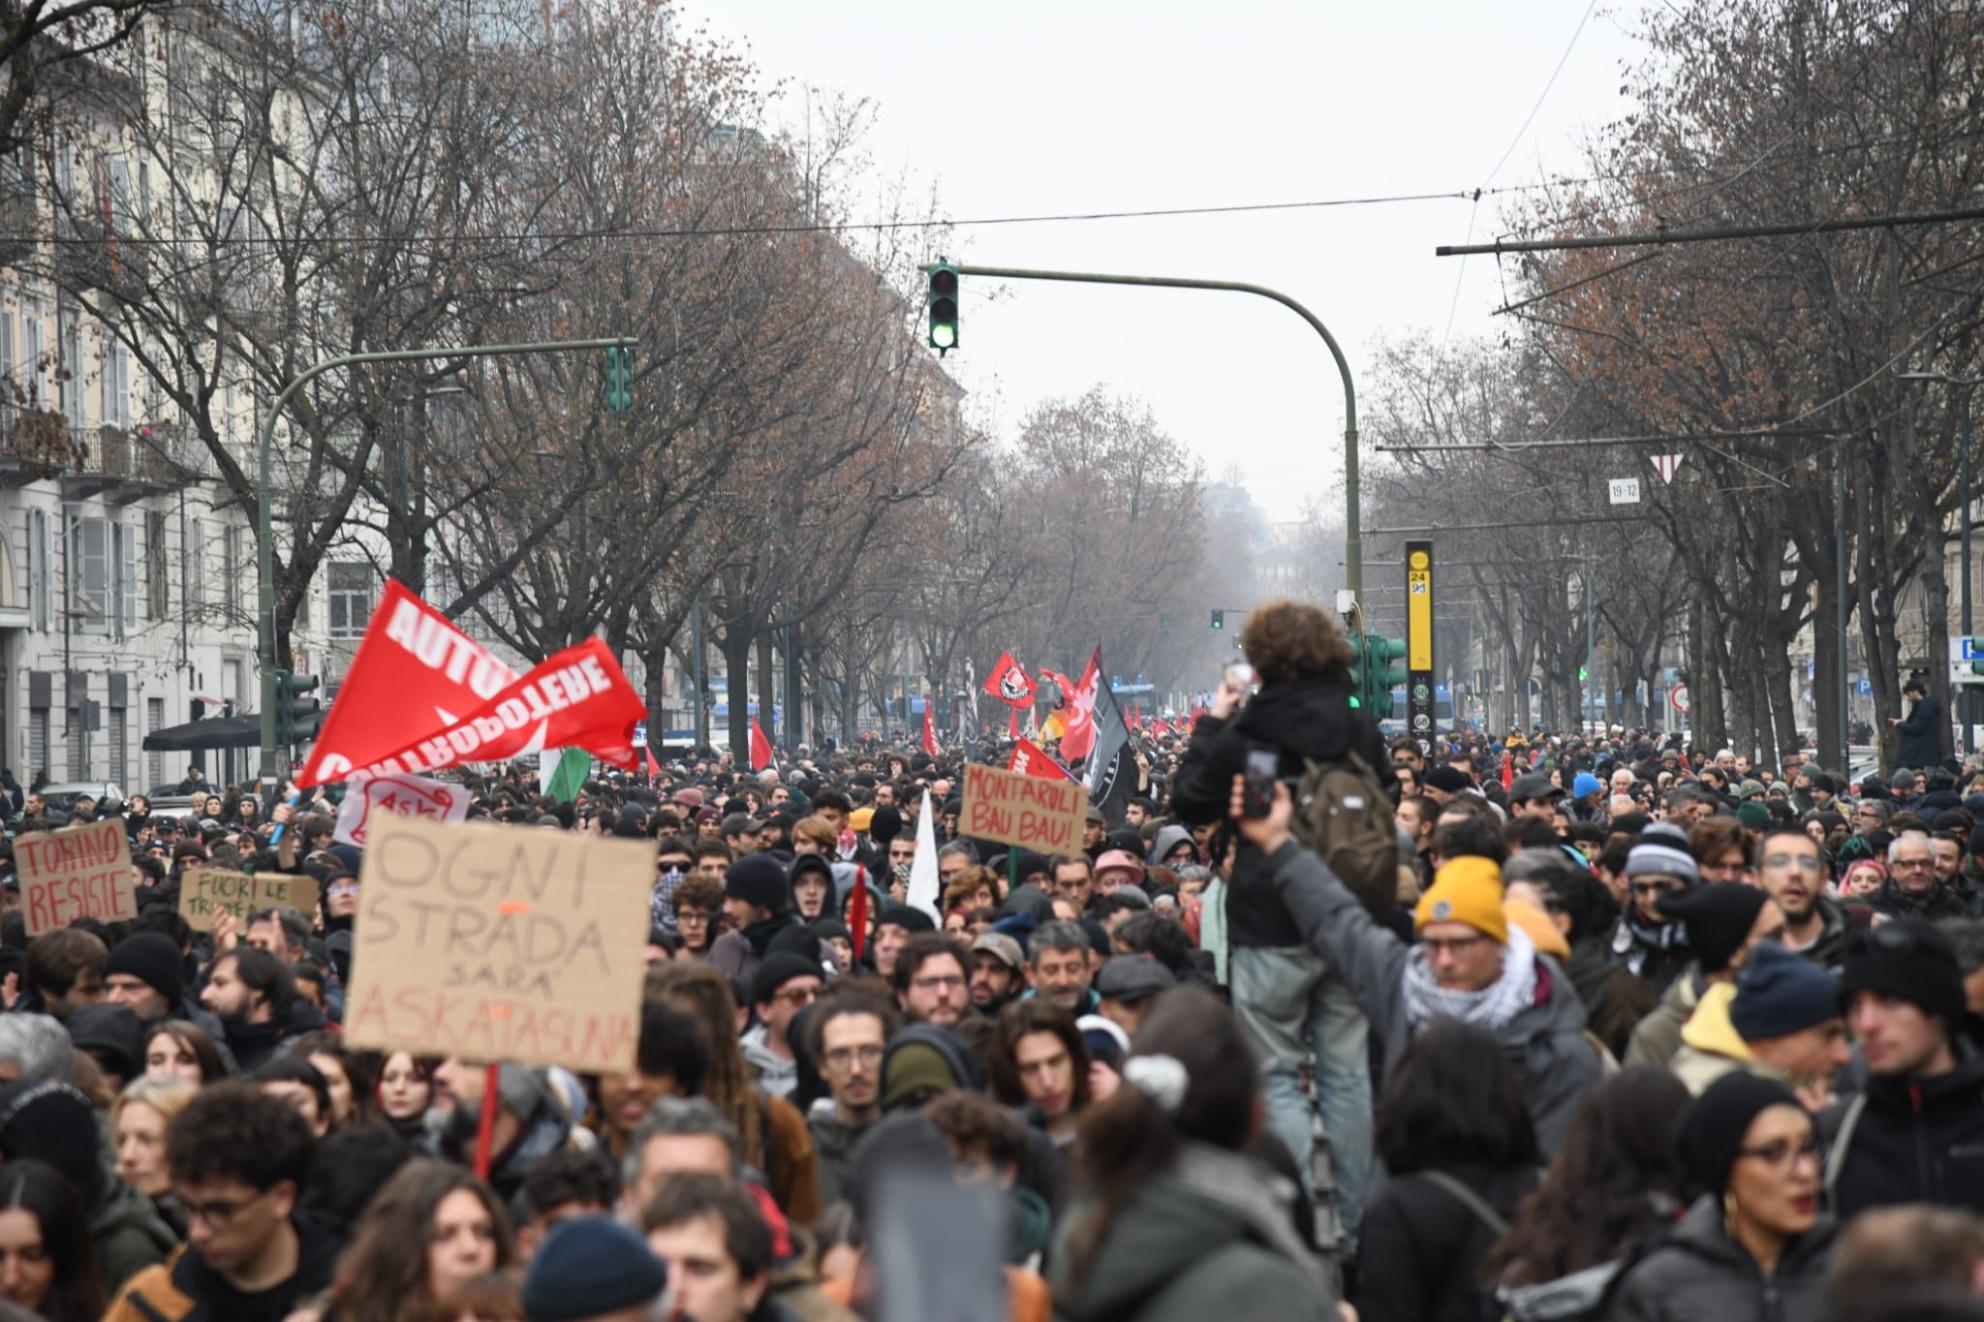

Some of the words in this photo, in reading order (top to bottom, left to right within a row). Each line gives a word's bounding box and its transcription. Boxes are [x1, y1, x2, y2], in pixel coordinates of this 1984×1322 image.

[1612, 485, 1637, 498] 19-12
[18, 824, 118, 878] TORINO
[971, 800, 1013, 835] BAU
[1018, 810, 1073, 850] BAU!
[198, 872, 257, 900] FUORI
[265, 881, 289, 901] LE
[374, 829, 590, 909] OGNI
[28, 868, 128, 934] RESISTE
[362, 894, 611, 976] STRADA
[350, 983, 637, 1066] ASKATASUNA
